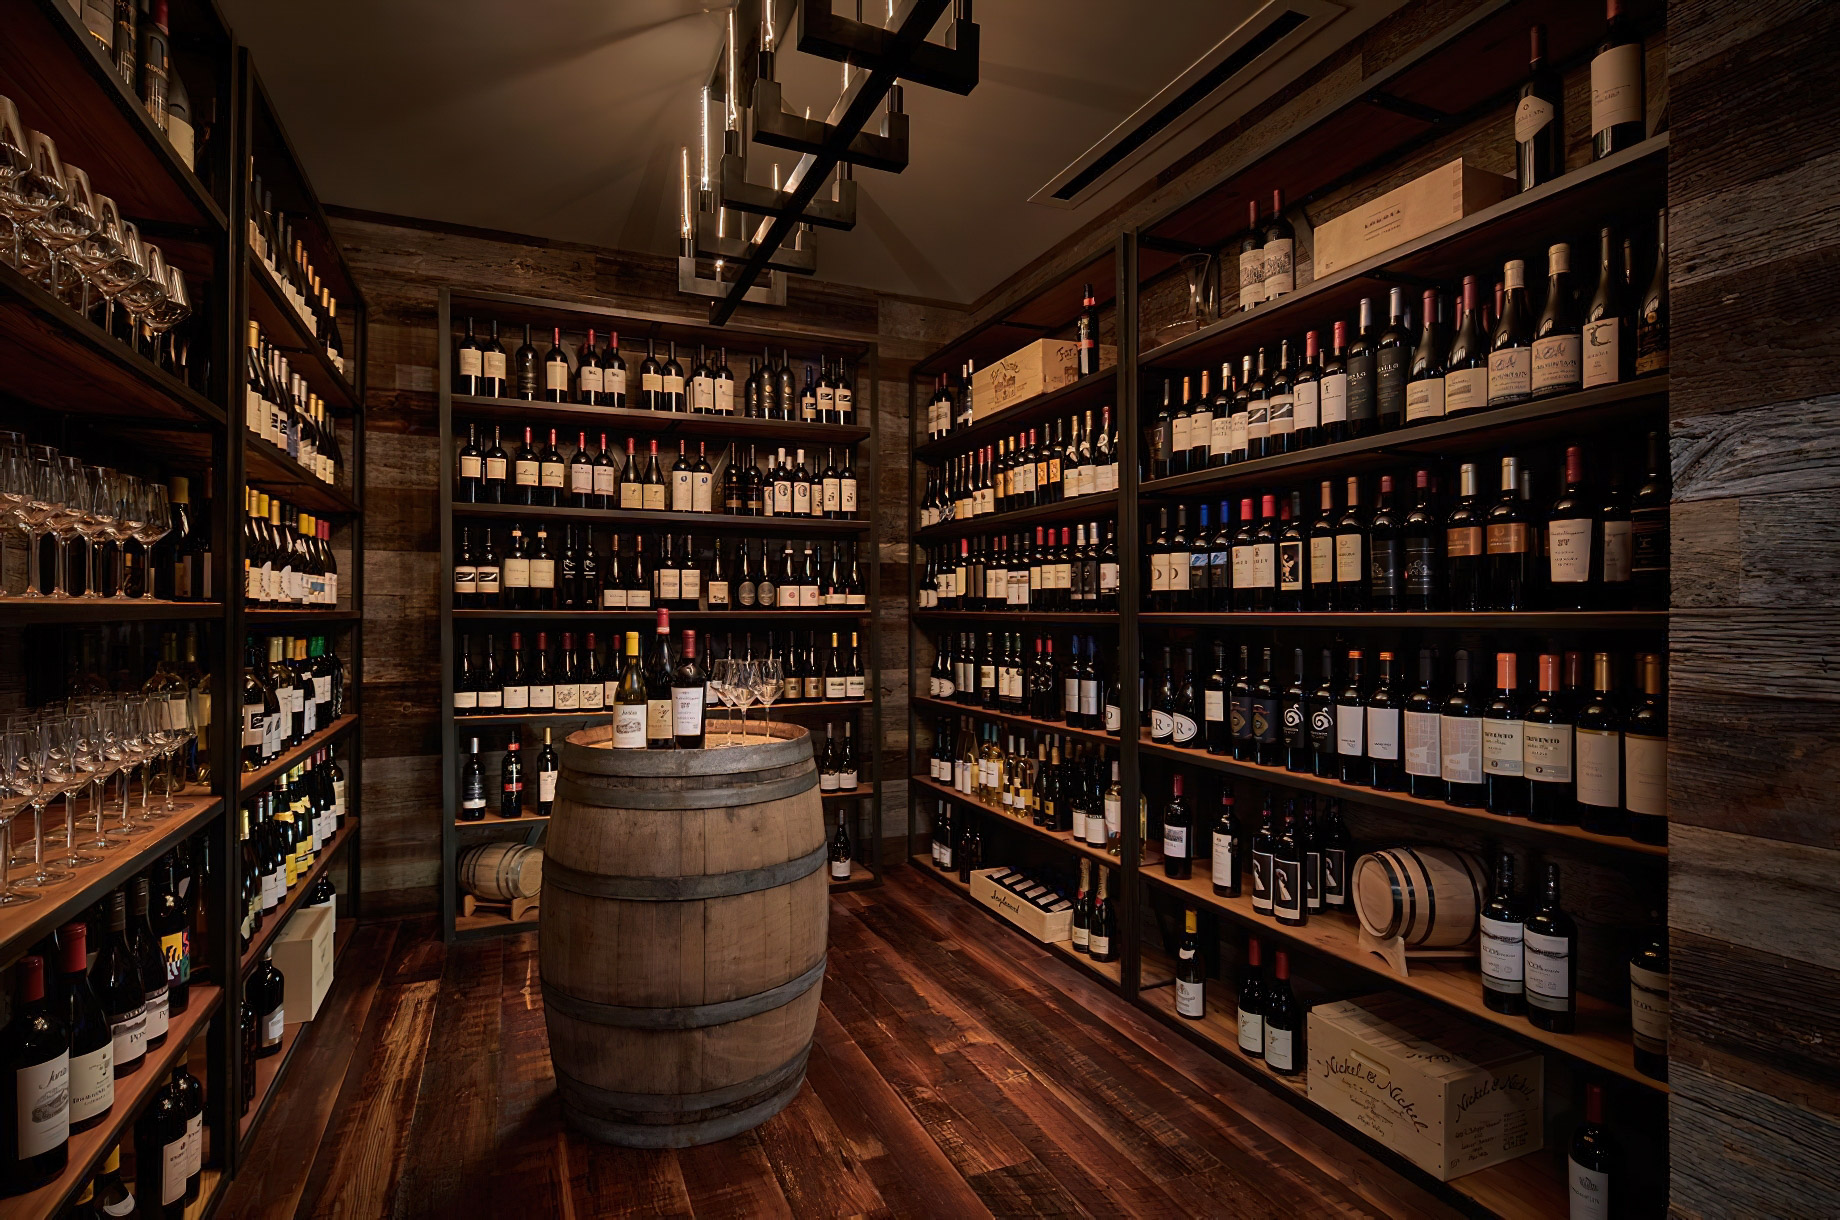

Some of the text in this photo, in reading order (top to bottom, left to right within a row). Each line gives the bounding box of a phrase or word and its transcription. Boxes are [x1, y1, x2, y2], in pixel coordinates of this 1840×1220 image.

[1324, 1056, 1365, 1078] Nickel
[1366, 1070, 1377, 1084] &
[1377, 1081, 1428, 1133] Nickel
[1455, 1080, 1490, 1123] Nickel
